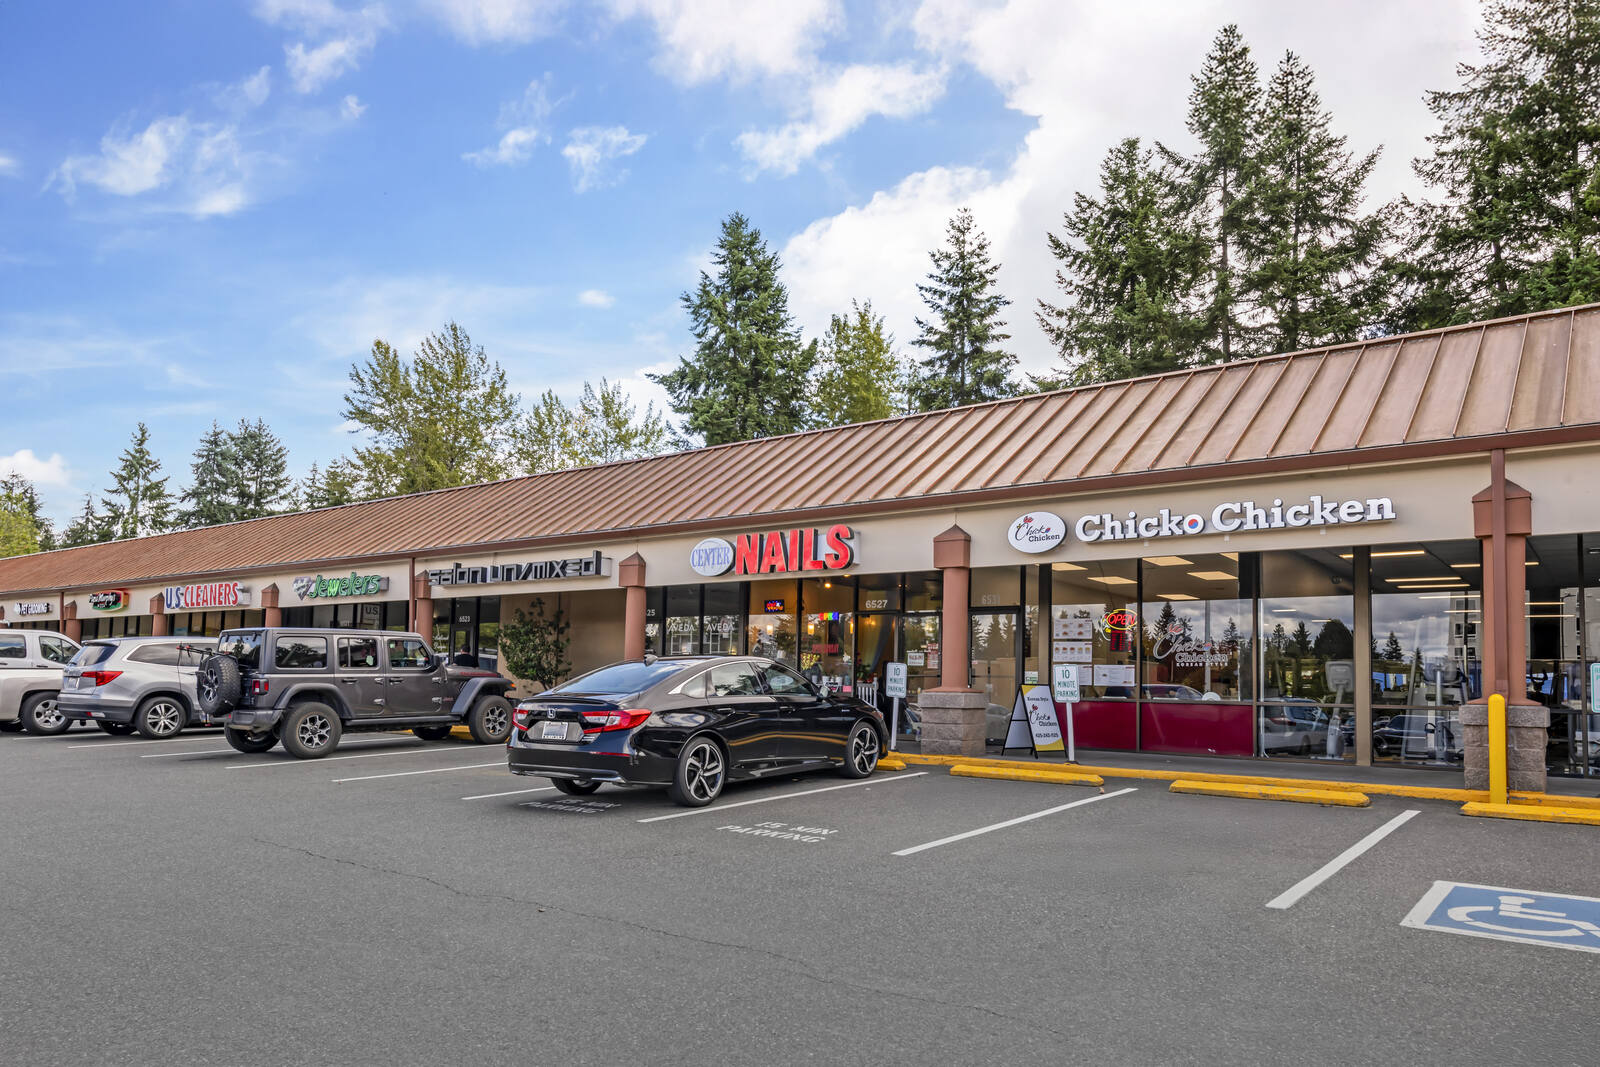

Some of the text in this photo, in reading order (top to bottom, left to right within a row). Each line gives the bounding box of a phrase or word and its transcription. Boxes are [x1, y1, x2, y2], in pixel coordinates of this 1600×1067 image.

[1075, 496, 1396, 542] Chicko Chicken
[1028, 534, 1060, 542] Chicken
[735, 523, 853, 576] NAILS
[691, 546, 730, 568] CENTER
[308, 572, 382, 598] Jewelers
[183, 582, 239, 608] CLEANERS
[865, 599, 889, 609] 6527
[1108, 613, 1136, 625] OPEN
[668, 623, 695, 632] AVEDA
[706, 622, 734, 632] AVEDA
[1175, 653, 1228, 662] Chicken
[893, 667, 901, 676] 10
[1061, 669, 1071, 679] 10
[1057, 680, 1076, 689] MINUTE
[1056, 690, 1078, 698] PARKING
[714, 825, 827, 842] PARKING
